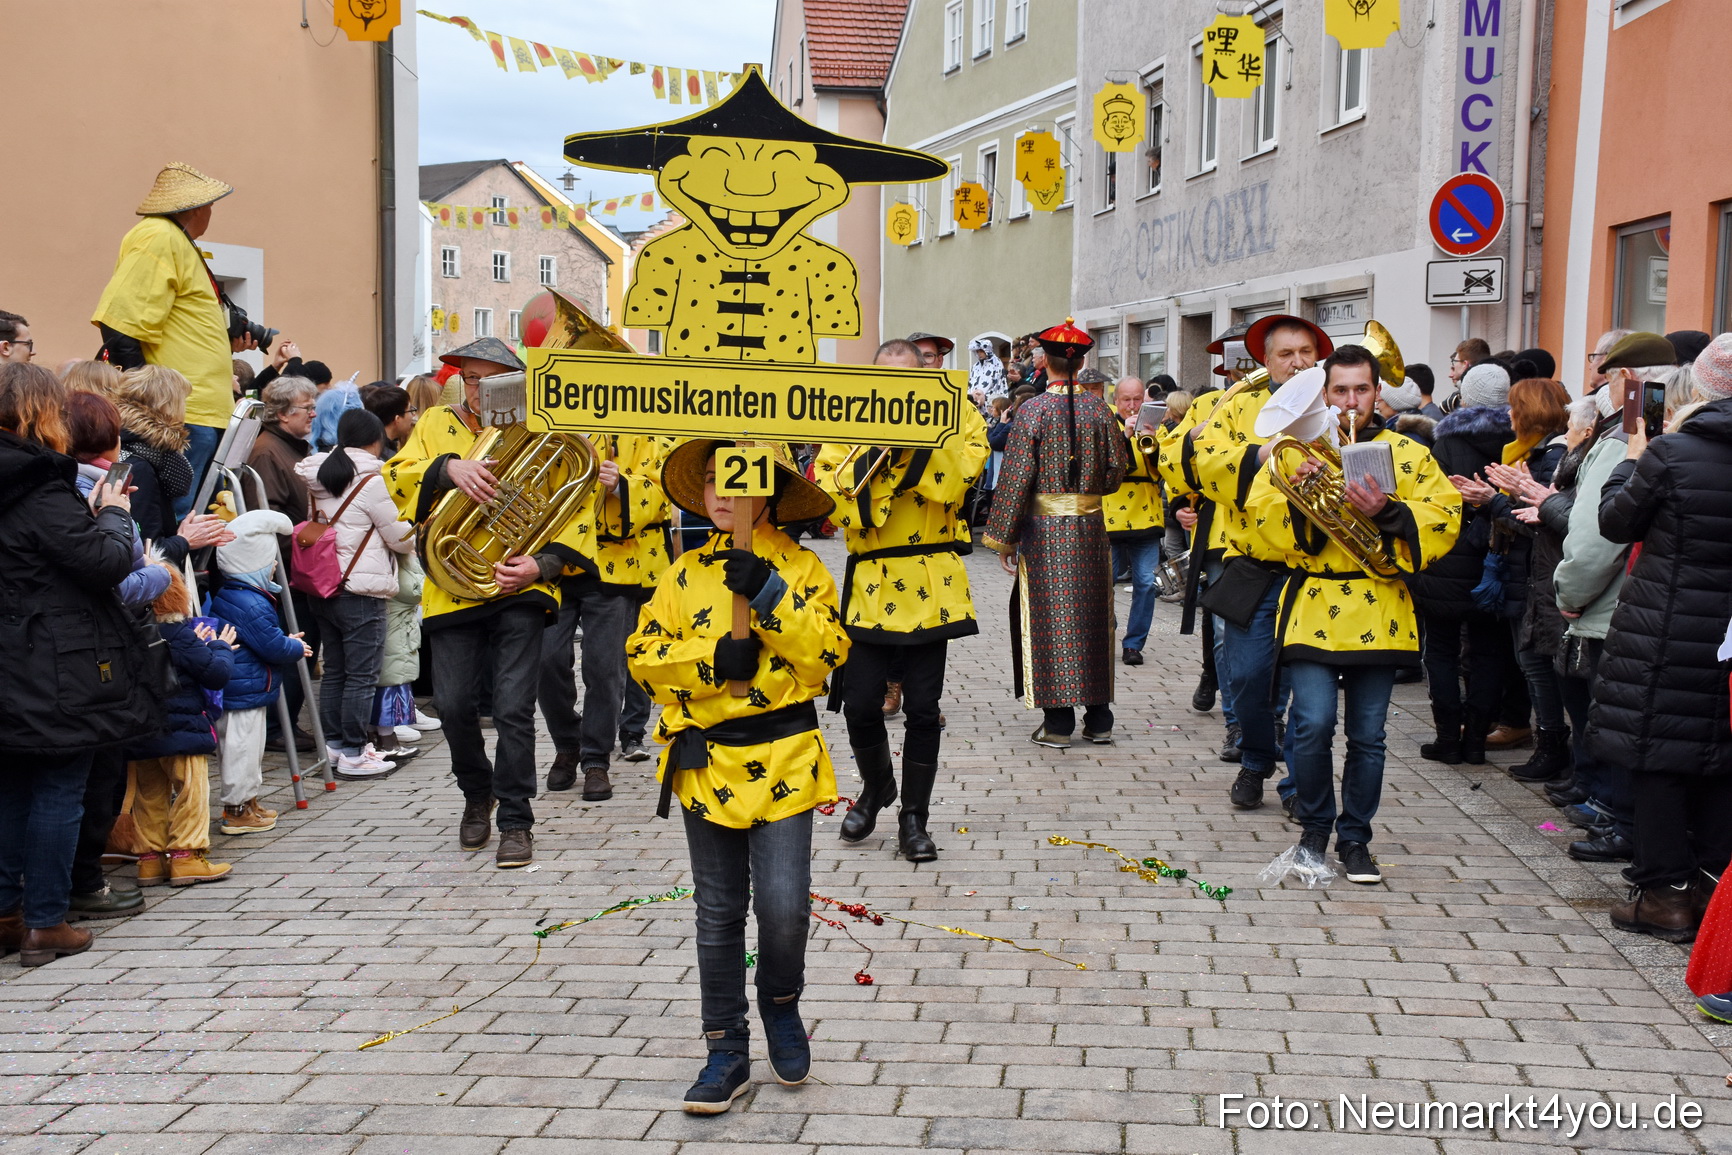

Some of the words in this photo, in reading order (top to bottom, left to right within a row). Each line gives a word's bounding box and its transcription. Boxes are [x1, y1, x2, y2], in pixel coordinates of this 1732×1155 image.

[1460, 0, 1501, 177] MUCK
[1135, 206, 1198, 281] OPTIK
[1203, 180, 1278, 267] OEXL
[543, 374, 777, 419] Bergmusikanten
[786, 384, 950, 427] Otterzhofen
[724, 455, 769, 490] 21
